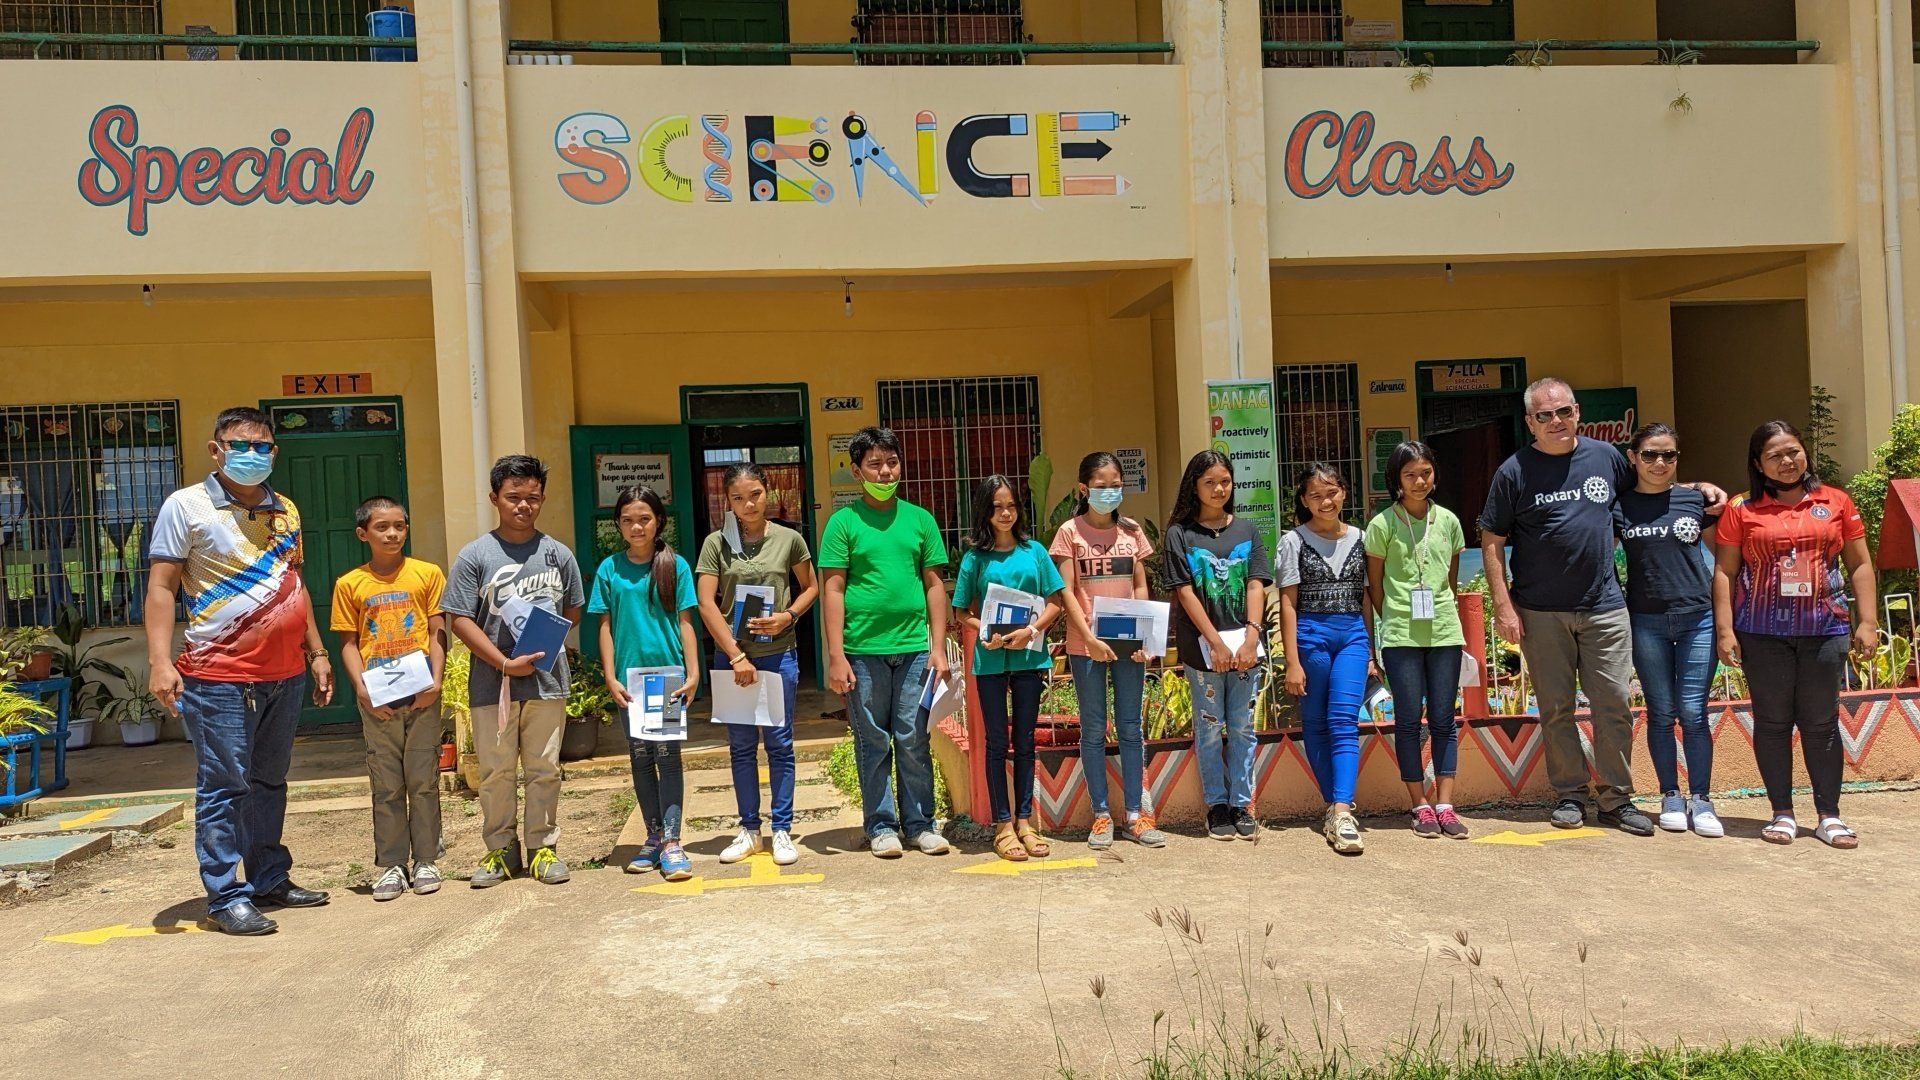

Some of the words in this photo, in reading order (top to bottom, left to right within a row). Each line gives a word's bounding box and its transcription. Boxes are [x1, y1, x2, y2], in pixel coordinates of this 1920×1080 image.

[78, 104, 375, 236] Special
[554, 111, 1132, 206] SCIENCE
[1284, 110, 1515, 199] Class
[294, 374, 361, 394] EXIT
[1370, 380, 1405, 392] Entrance
[825, 397, 860, 410] Exit
[1209, 390, 1269, 410] DAN-AG
[1211, 416, 1269, 438] Proactively
[604, 462, 630, 472] Thank
[631, 464, 645, 472] you
[646, 462, 661, 471] and
[601, 473, 620, 482] hope
[621, 474, 635, 482] you
[637, 472, 664, 482] enjoyed
[1233, 479, 1271, 490] eversing
[1535, 488, 1581, 505] Rotary
[1621, 525, 1668, 540] Rotary
[1077, 543, 1133, 558] DICKIES
[1080, 559, 1112, 577] LIFE
